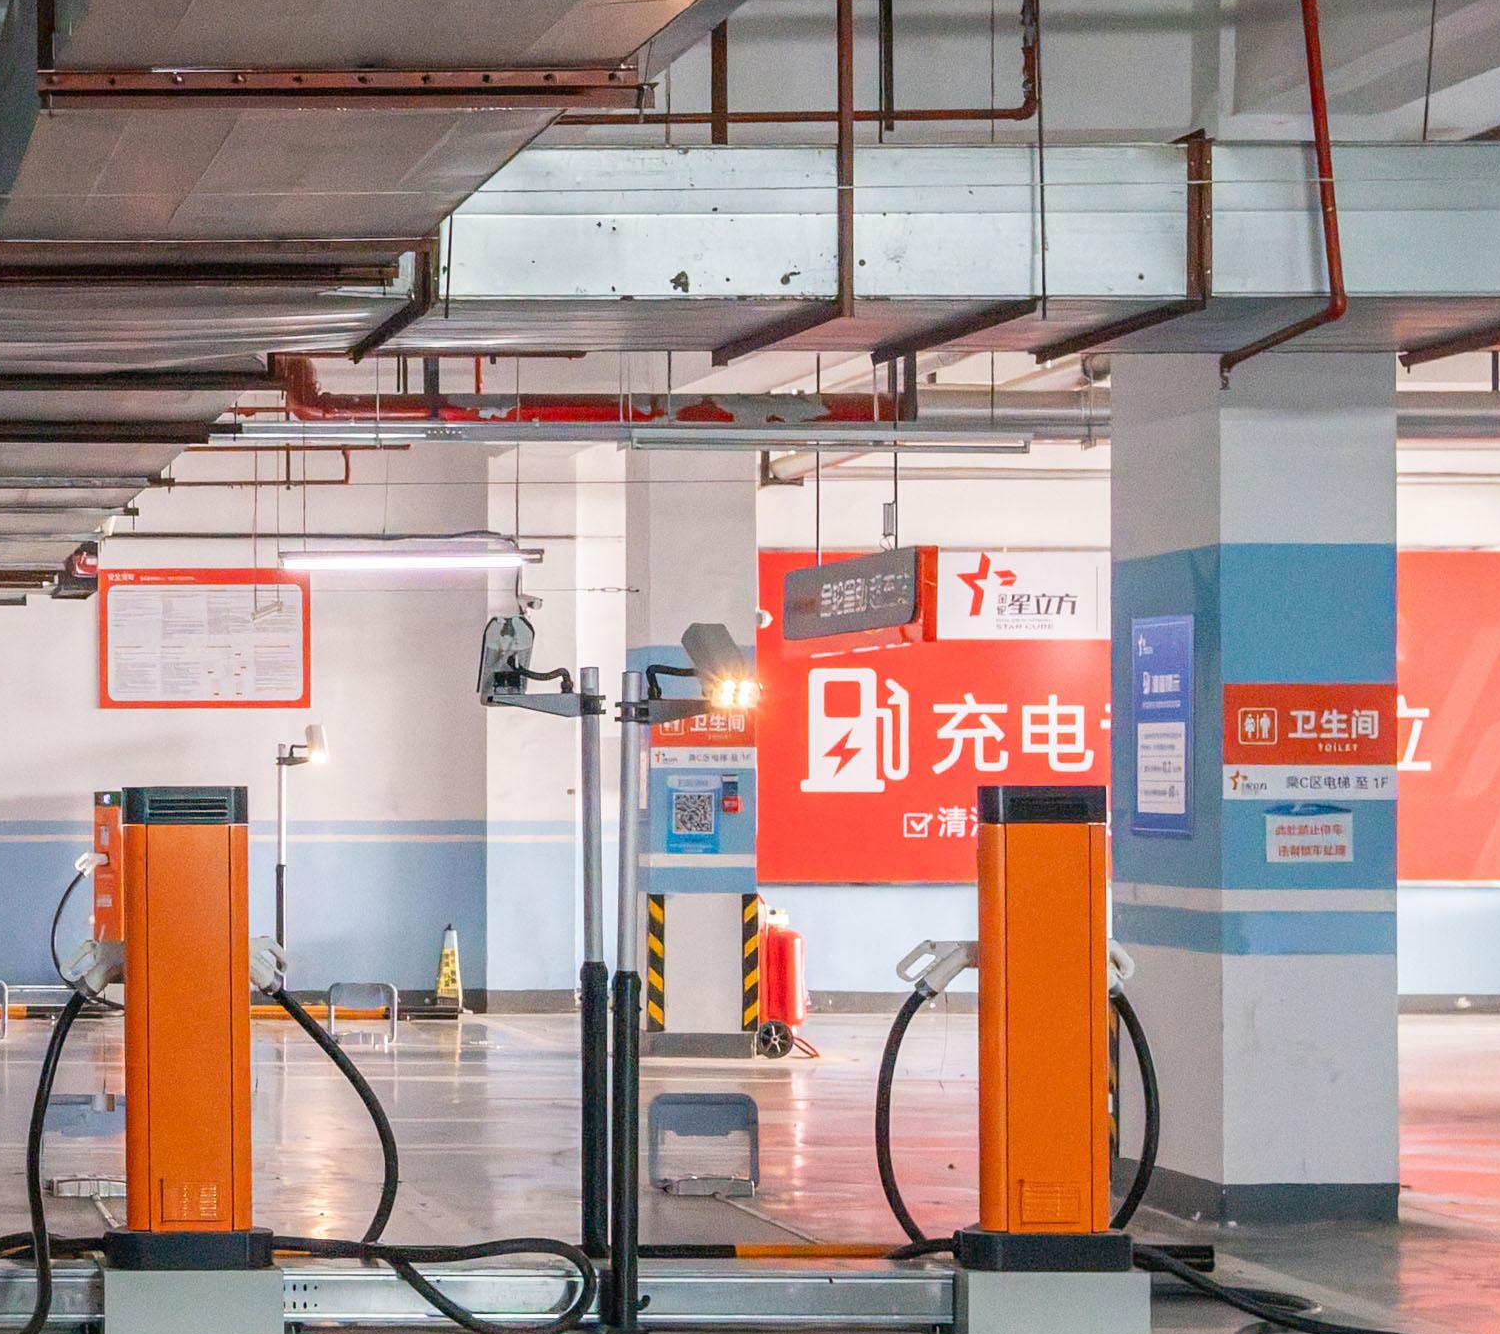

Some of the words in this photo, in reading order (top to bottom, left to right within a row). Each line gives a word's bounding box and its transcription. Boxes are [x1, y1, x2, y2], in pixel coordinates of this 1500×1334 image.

[689, 713, 746, 733] 卫生间
[1287, 708, 1380, 740] 卫生间
